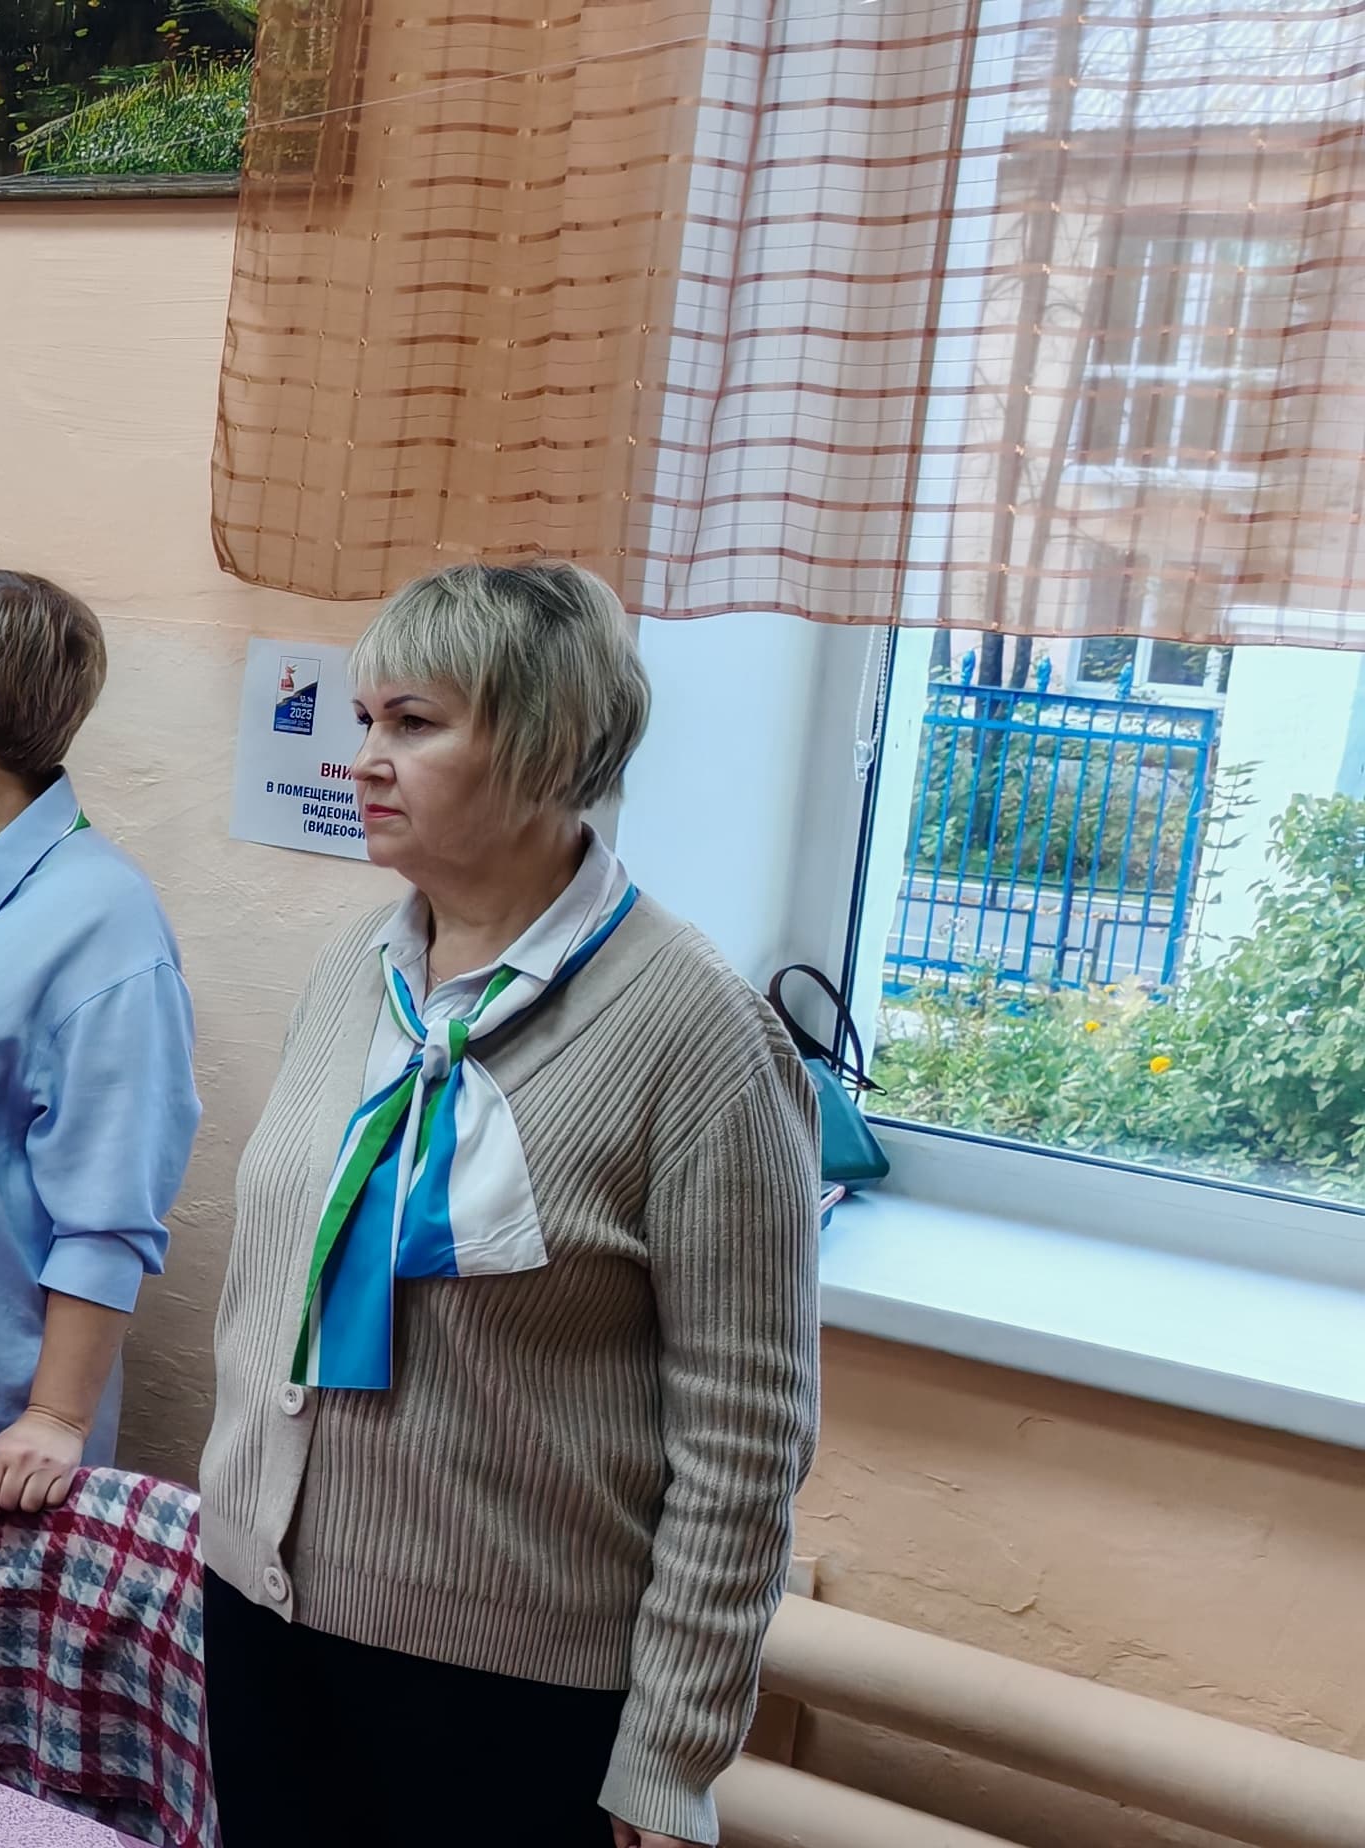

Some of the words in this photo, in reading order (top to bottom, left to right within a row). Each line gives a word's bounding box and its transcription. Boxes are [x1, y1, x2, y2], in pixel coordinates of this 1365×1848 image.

[289, 707, 313, 721] 2025
[266, 781, 274, 793] В
[277, 783, 354, 804] ПОМЕЩЕНИИ
[302, 803, 364, 822] ВИДЕОНА
[303, 819, 366, 839] (ВИДЕОФИ
